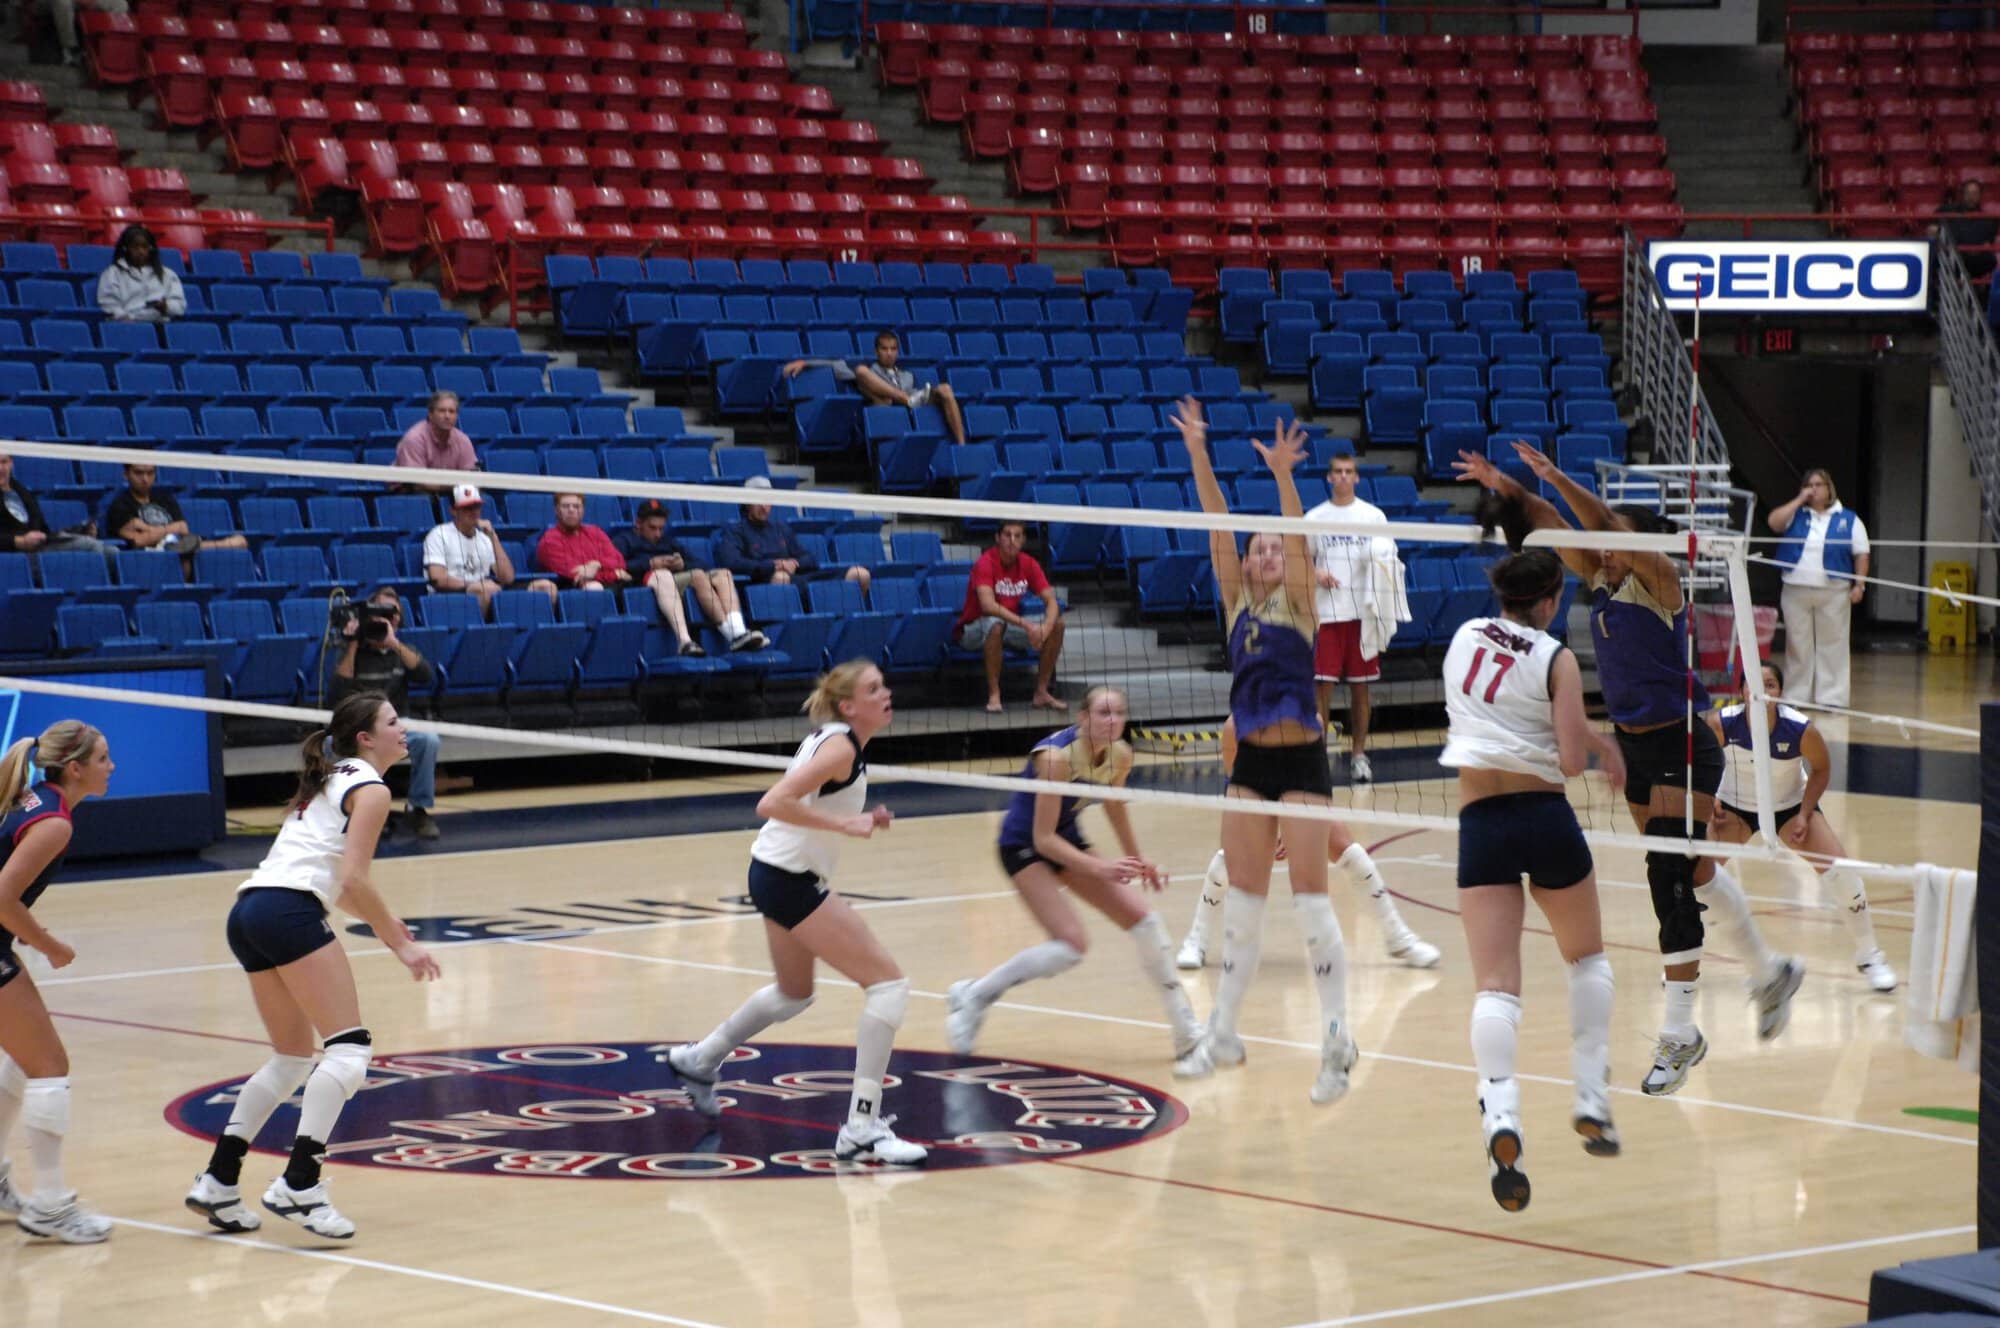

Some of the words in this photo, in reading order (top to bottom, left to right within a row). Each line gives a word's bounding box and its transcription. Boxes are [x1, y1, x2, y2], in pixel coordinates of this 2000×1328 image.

[1248, 14, 1266, 34] 18
[841, 249, 858, 264] 17
[1461, 256, 1482, 275] 18
[1655, 253, 1923, 300] GEICO
[1765, 329, 1793, 351] EXIT
[1243, 621, 1262, 655] 2
[1462, 647, 1516, 704] 17
[912, 1062, 1158, 1129] LUTE
